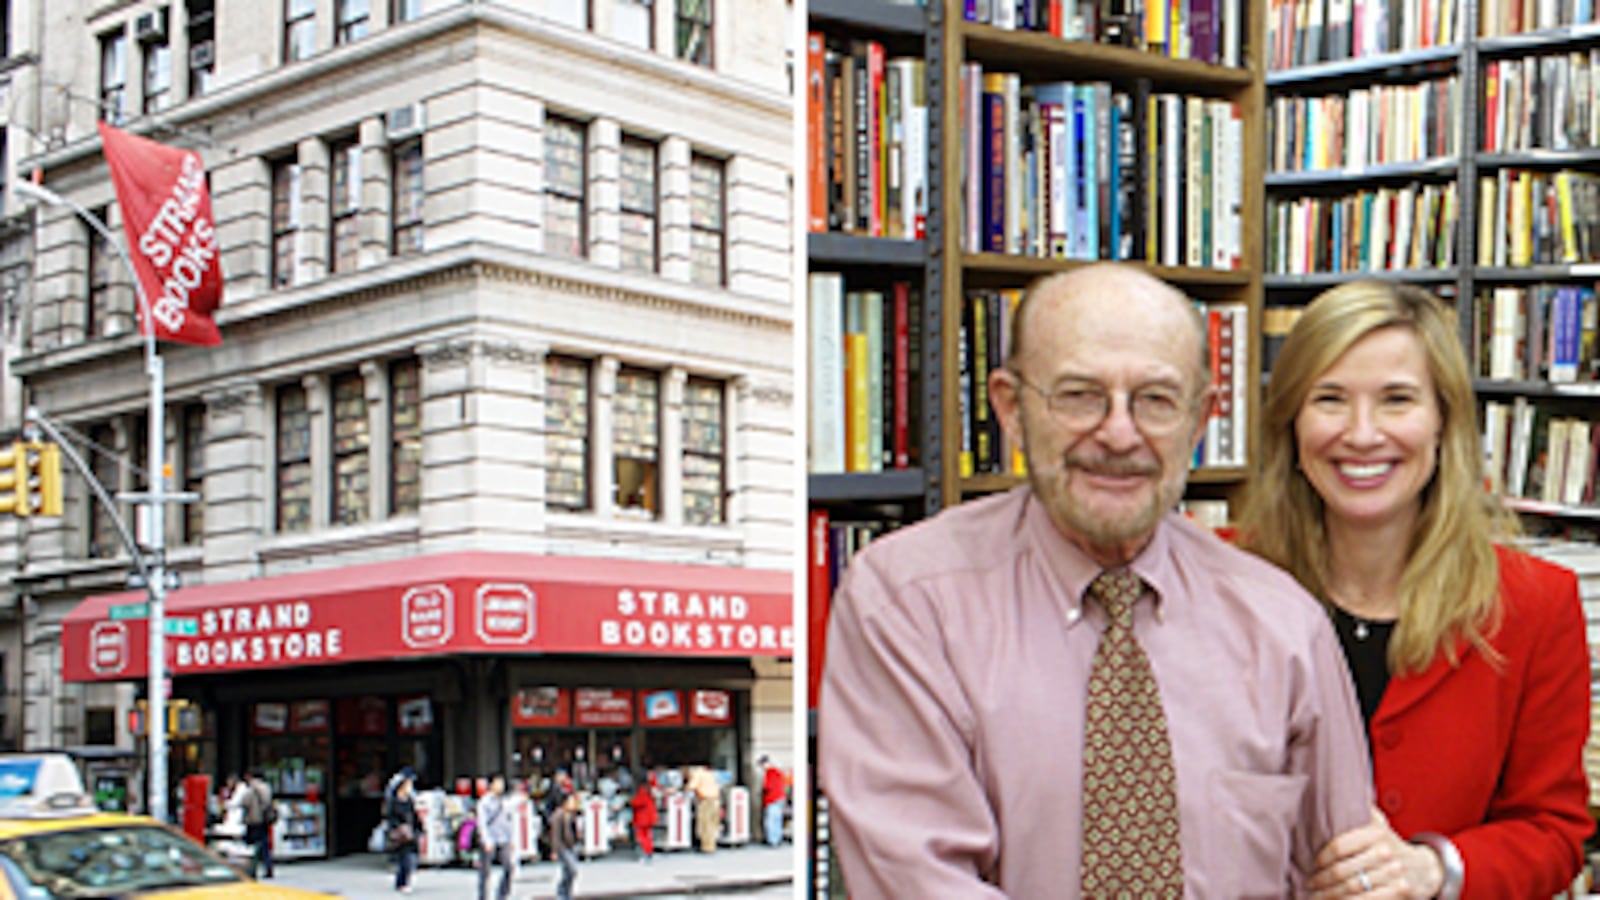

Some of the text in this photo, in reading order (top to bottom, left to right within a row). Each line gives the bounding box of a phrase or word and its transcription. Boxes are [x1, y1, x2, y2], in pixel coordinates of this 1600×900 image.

[153, 218, 217, 331] BOOKS
[203, 604, 310, 633] STRAND
[618, 591, 747, 619] STRAND
[177, 630, 342, 664] BOOKSTORE
[601, 621, 794, 648] BOOKSTORE
